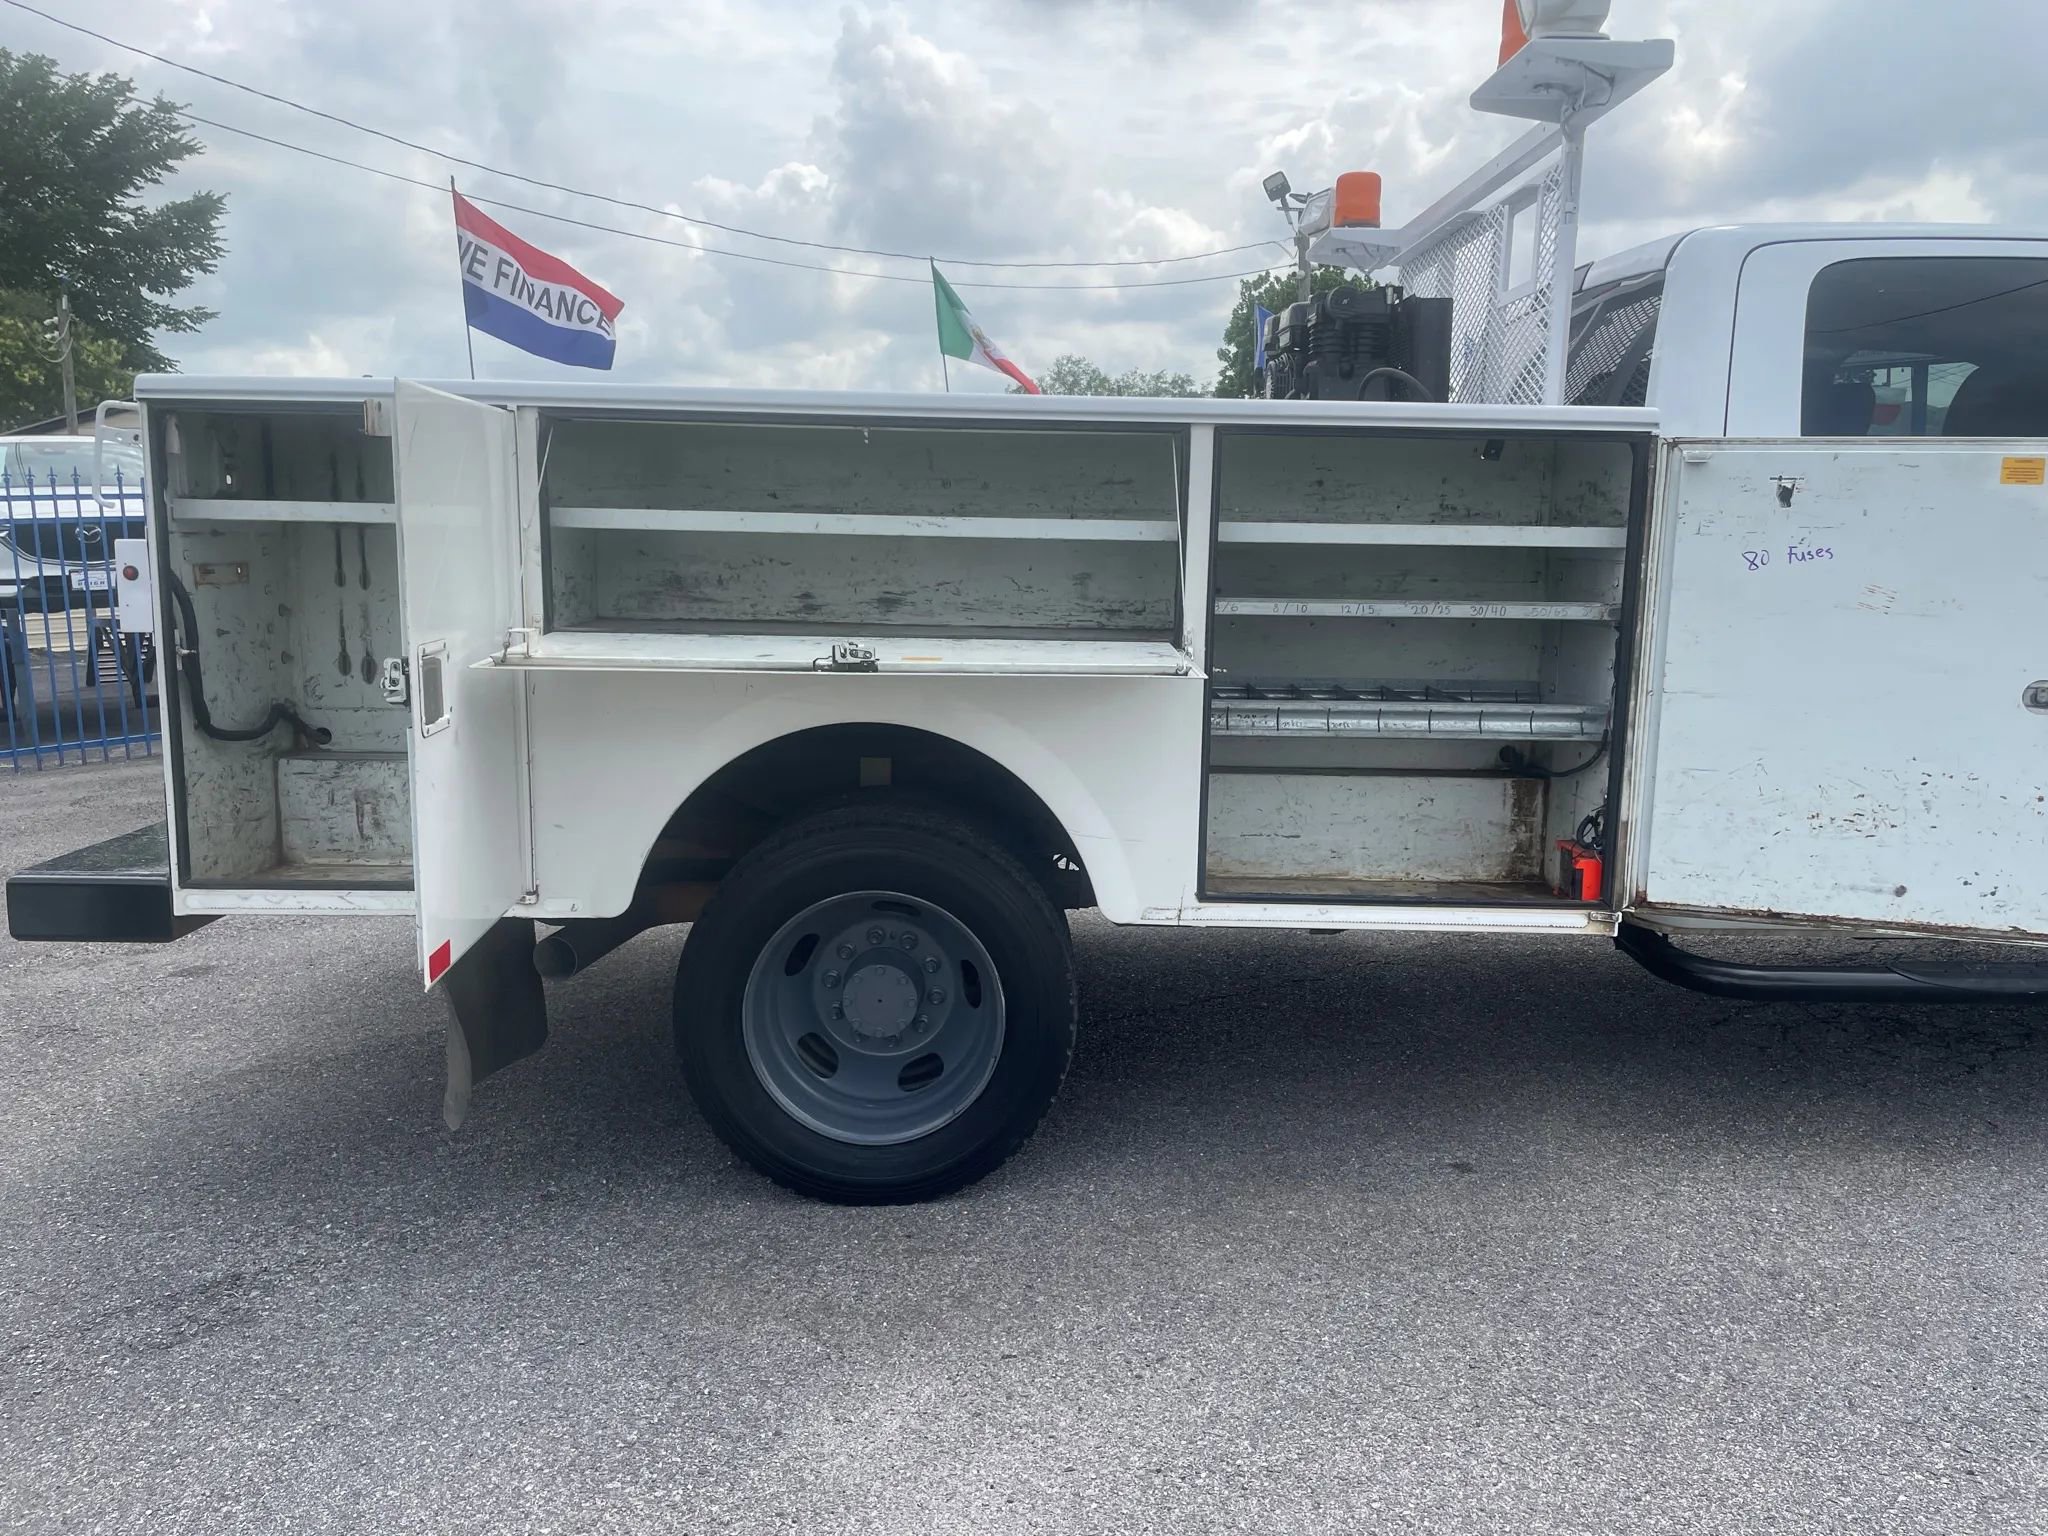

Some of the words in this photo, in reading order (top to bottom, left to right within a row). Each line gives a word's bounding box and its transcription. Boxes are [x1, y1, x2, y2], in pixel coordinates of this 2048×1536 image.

[493, 256, 611, 336] FINANCE
[1741, 549, 1770, 571] 80
[1787, 546, 1834, 565] Fuses
[1341, 602, 1376, 615] 12/15
[1470, 605, 1507, 617] 30/40
